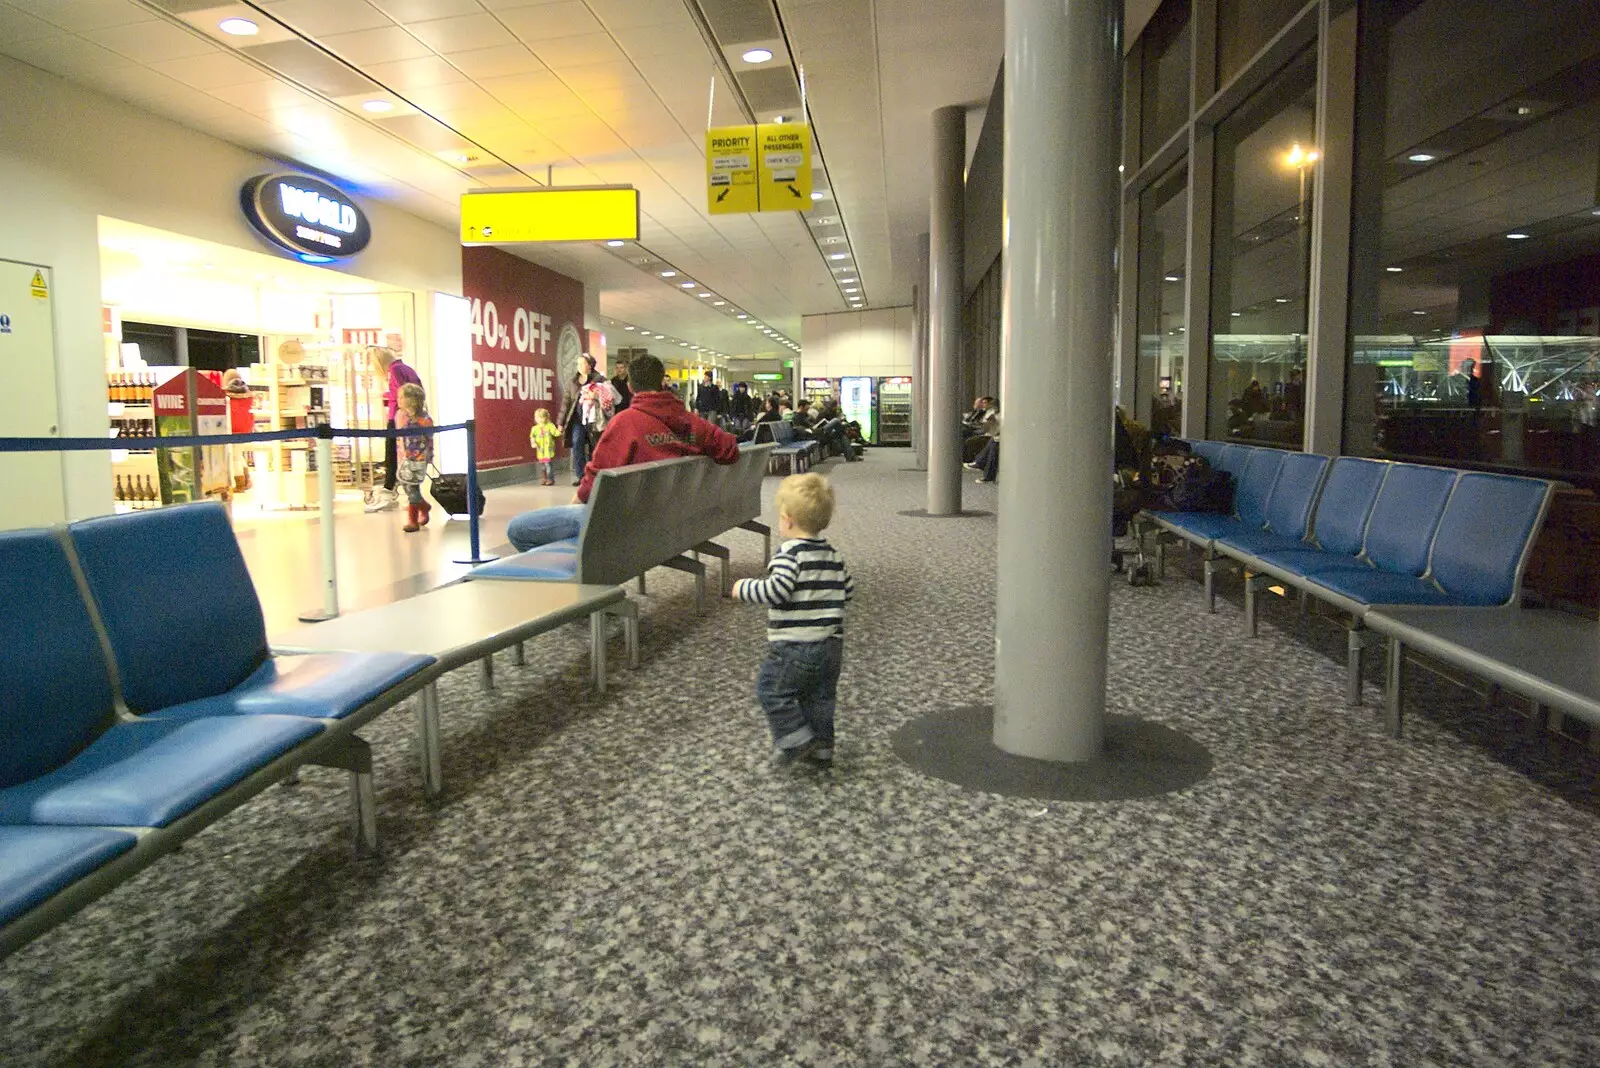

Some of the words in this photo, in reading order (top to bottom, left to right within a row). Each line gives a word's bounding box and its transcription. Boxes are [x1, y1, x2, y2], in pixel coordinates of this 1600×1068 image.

[712, 137, 750, 148] PRIORITY
[764, 143, 803, 151] PASSENGERS
[471, 298, 511, 351] 40%
[513, 307, 552, 355] OFF
[472, 360, 555, 401] PERFUME
[157, 394, 185, 409] WINE
